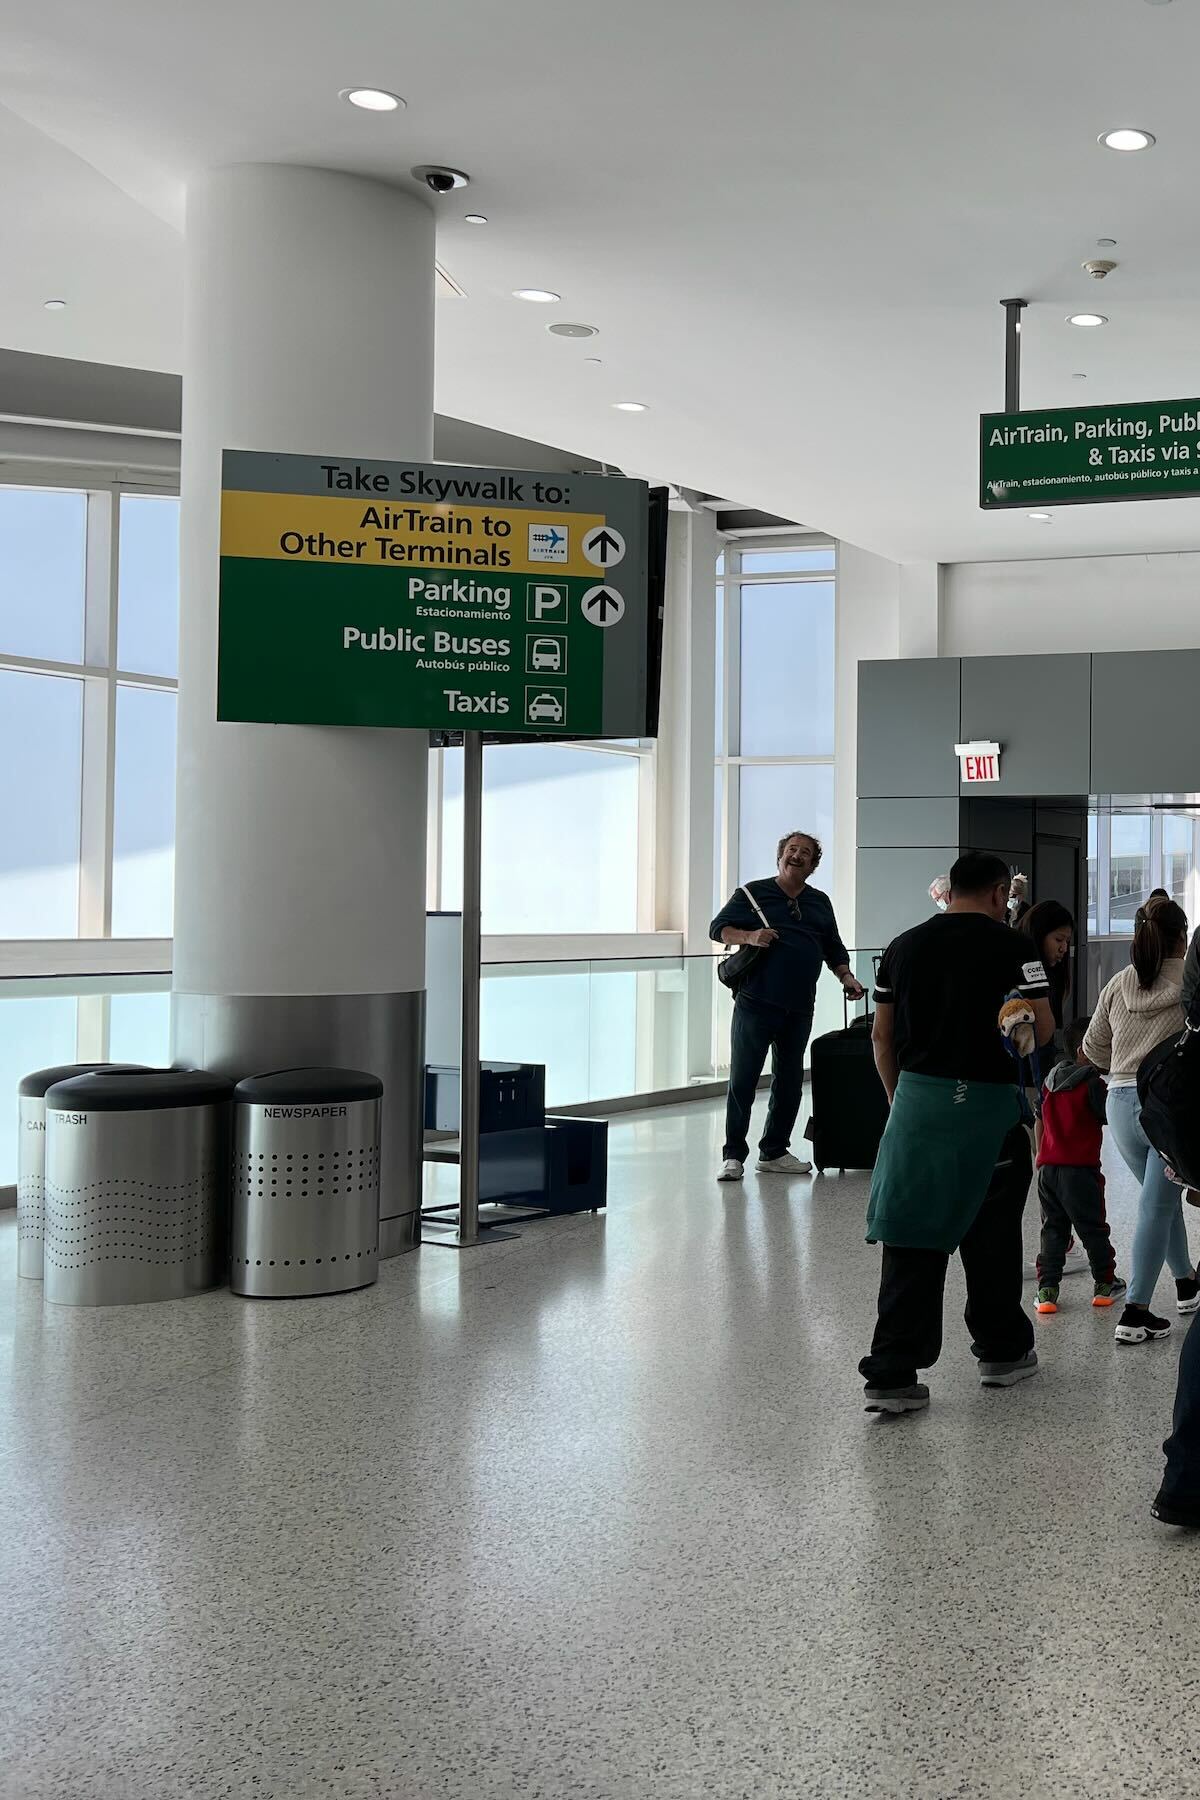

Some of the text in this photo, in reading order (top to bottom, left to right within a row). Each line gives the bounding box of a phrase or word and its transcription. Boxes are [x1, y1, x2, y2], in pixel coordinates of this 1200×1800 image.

[989, 423, 1069, 446] AirTrain,
[1074, 418, 1153, 440] Parking,
[1088, 448, 1103, 466] &
[1108, 443, 1156, 464] Taxis
[1161, 441, 1190, 460] via
[320, 465, 571, 505] Take Skywalk to:
[1022, 474, 1092, 487] estacionamiento,
[1094, 470, 1129, 481] autobús
[1130, 469, 1162, 480] público
[1163, 470, 1169, 479] y
[1171, 466, 1192, 477] taxis
[360, 506, 512, 537] AirTrain to
[280, 531, 511, 567] Other Terminals
[408, 577, 511, 610] Parking
[416, 606, 511, 620] Estacionamiento
[343, 626, 511, 657] Public Buses
[415, 658, 510, 673] Autobús público
[443, 689, 510, 714] Taxis
[966, 756, 994, 780] EXIT
[55, 1113, 87, 1125] TRASH
[264, 1106, 347, 1119] NEWSPAPER
